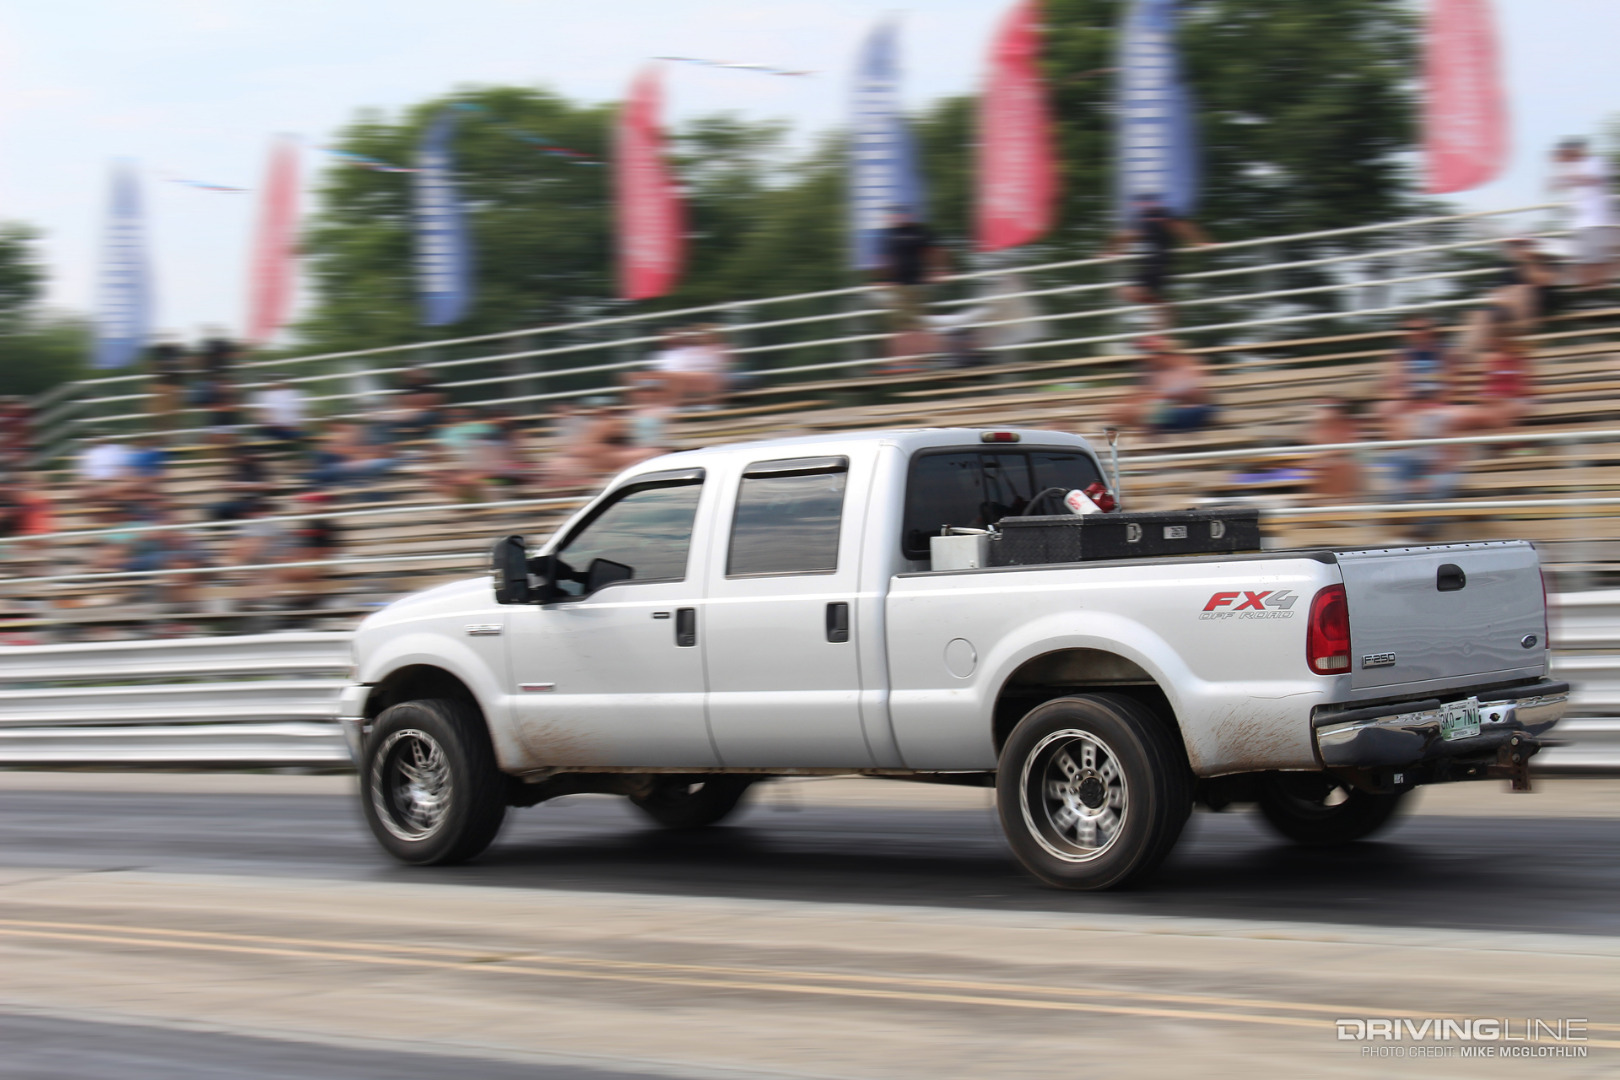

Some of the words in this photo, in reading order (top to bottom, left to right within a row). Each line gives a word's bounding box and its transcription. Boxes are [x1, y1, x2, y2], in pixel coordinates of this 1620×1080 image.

[1202, 590, 1299, 611] FX4
[1199, 612, 1235, 620] OFF
[1239, 611, 1294, 619] ROAD
